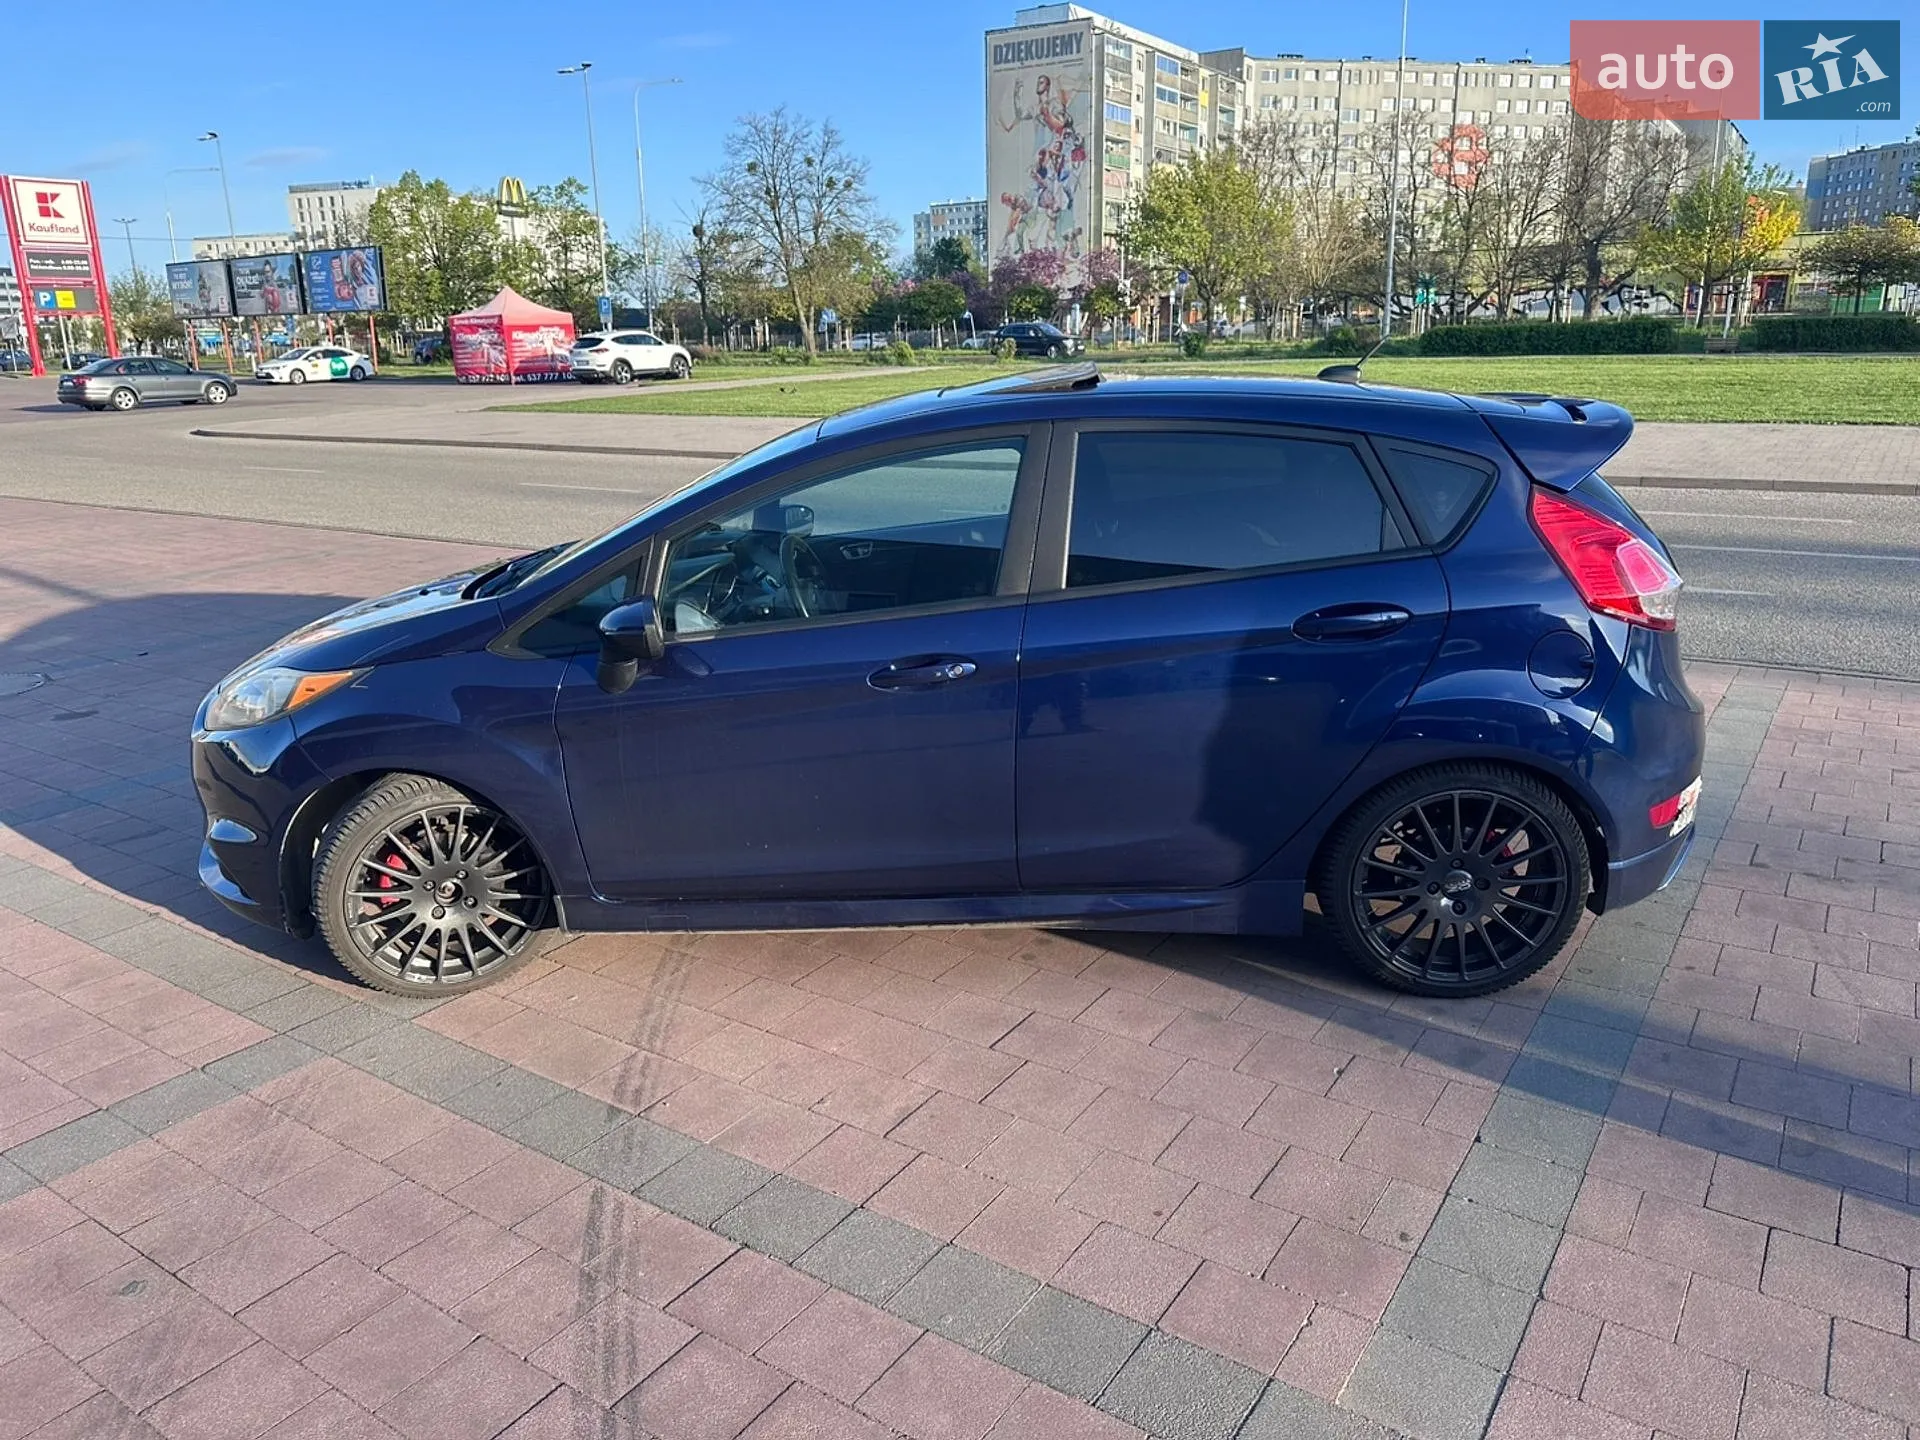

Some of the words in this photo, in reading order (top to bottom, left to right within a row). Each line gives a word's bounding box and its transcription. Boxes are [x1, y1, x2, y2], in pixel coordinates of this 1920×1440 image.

[993, 31, 1084, 65] DZIĘKUJEMY
[28, 222, 80, 234] Kaufland
[39, 291, 51, 307] P
